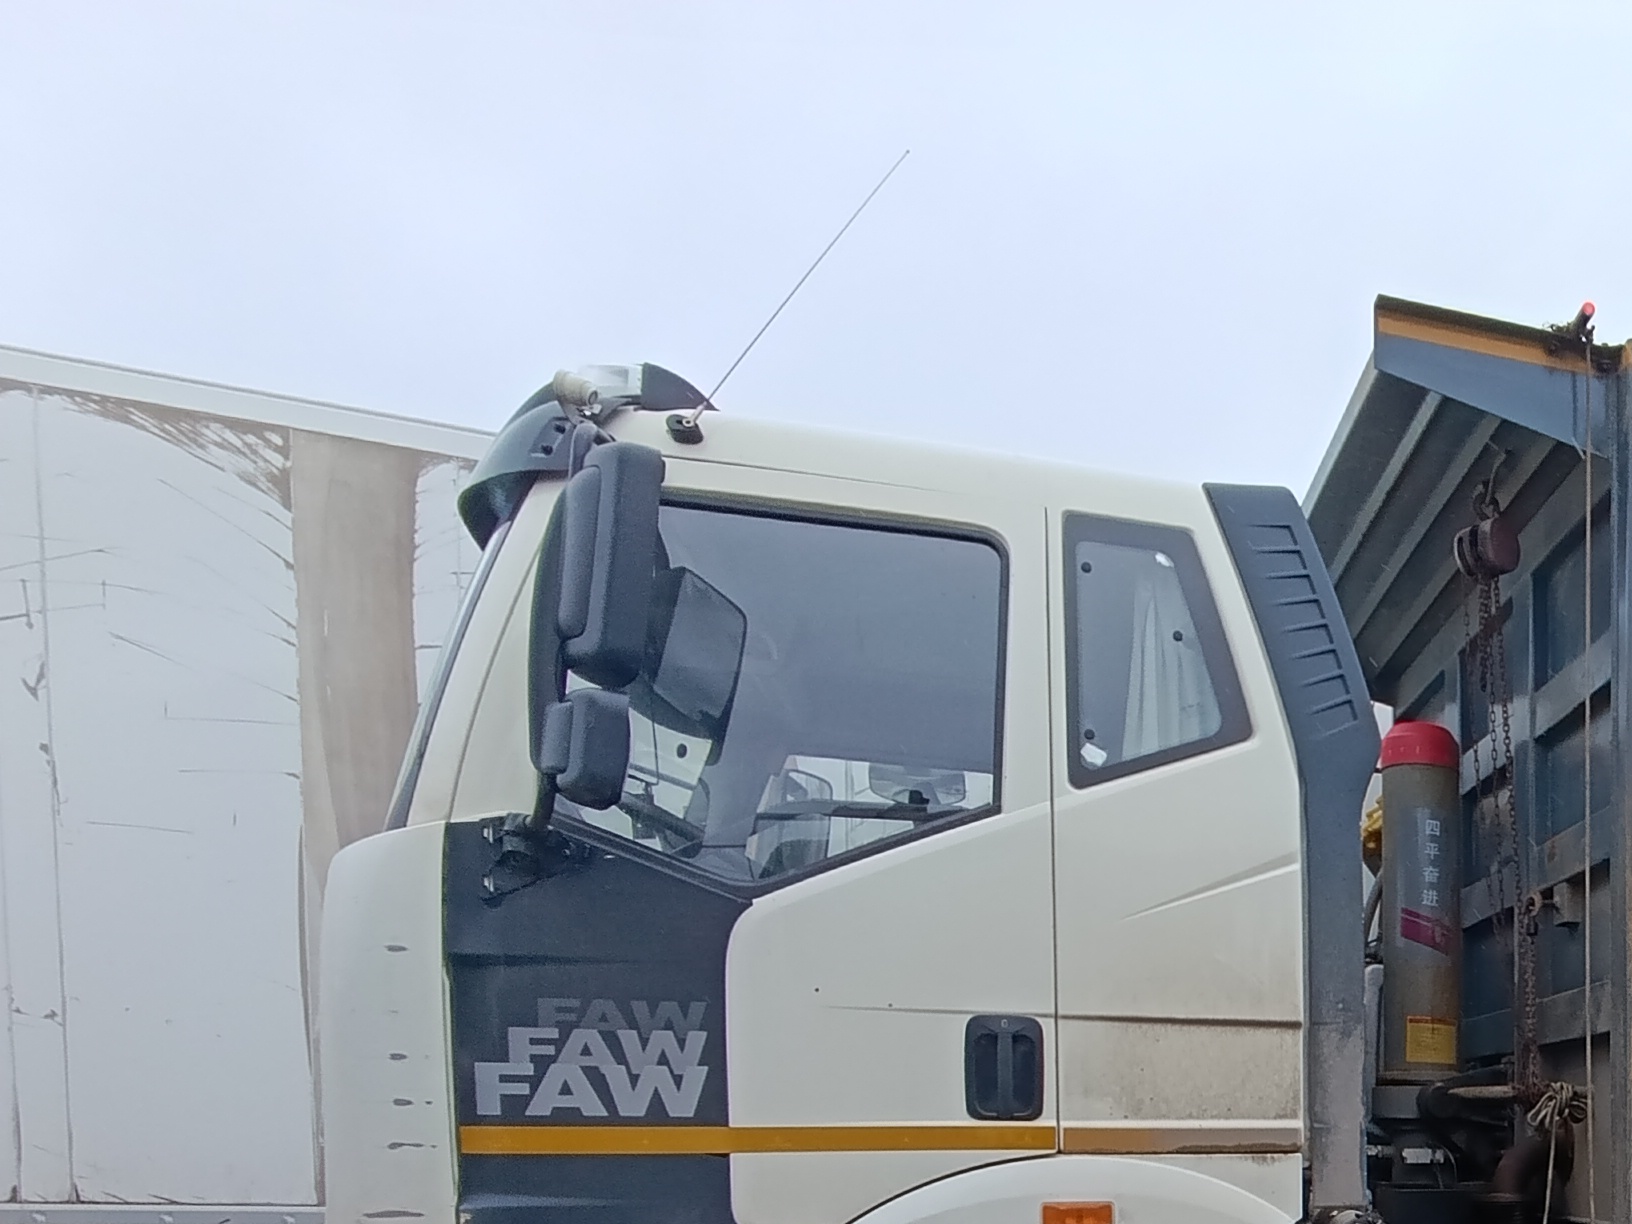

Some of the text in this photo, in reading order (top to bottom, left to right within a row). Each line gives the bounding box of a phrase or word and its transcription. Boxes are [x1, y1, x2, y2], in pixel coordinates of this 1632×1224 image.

[537, 997, 707, 1038] FAW
[508, 1027, 707, 1074] FAW
[474, 1062, 708, 1117] FAW
